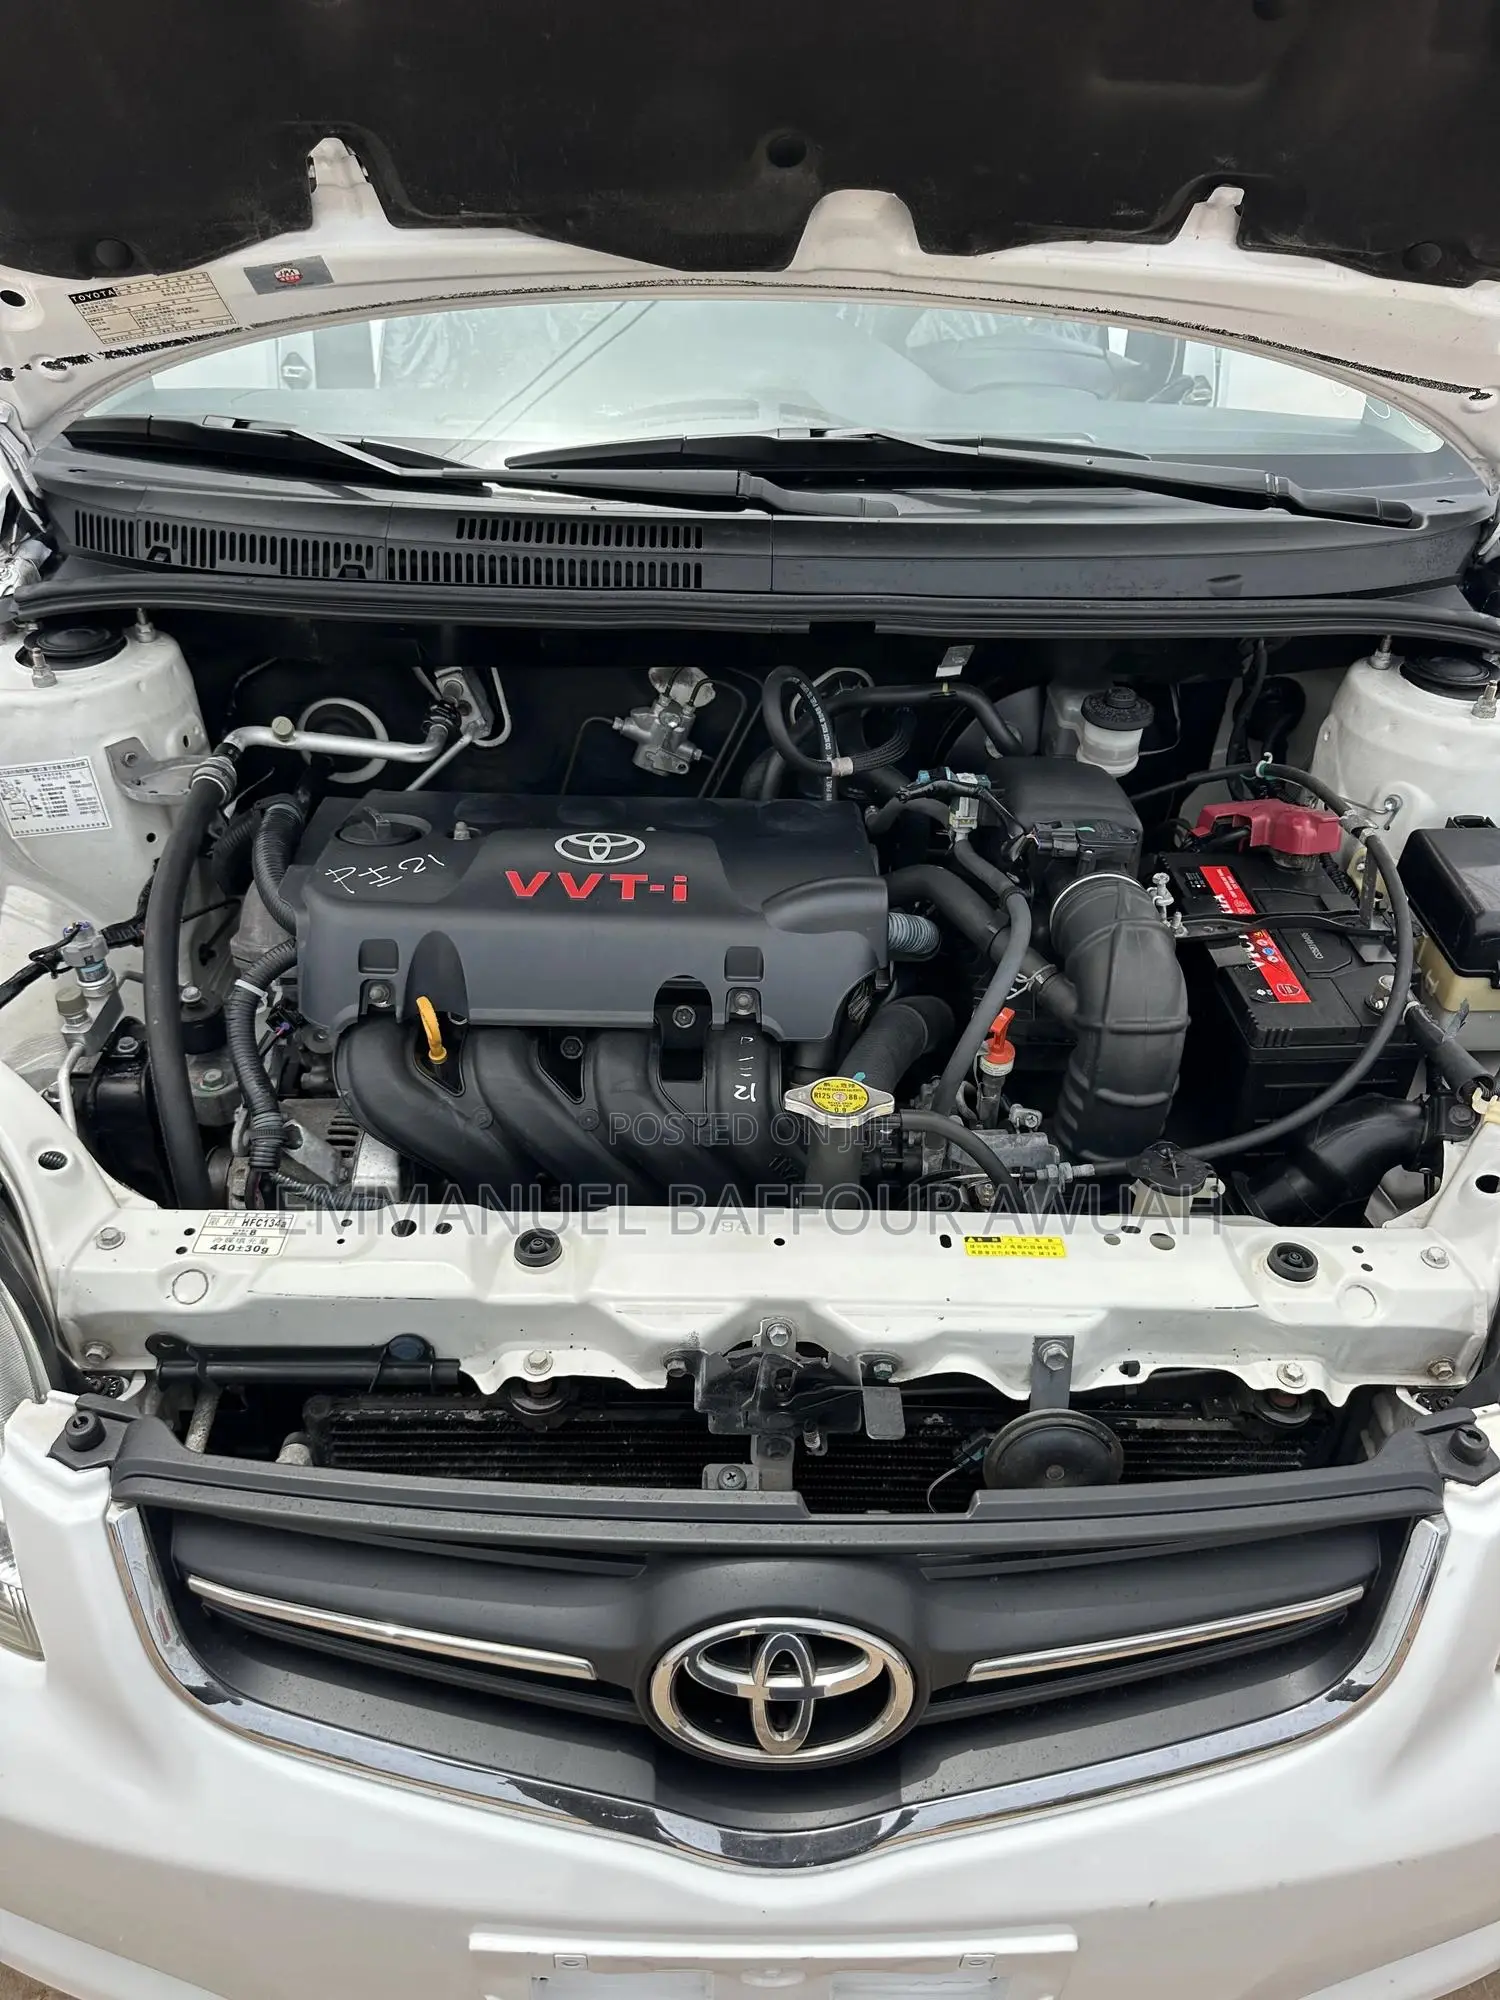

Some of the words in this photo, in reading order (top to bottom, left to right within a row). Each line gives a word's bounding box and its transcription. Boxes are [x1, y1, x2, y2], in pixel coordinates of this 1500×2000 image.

[71, 289, 115, 303] TOYOTA
[505, 869, 689, 903] VVT-i
[241, 1218, 287, 1228] HFC134a
[210, 1244, 270, 1255] 440±30g
